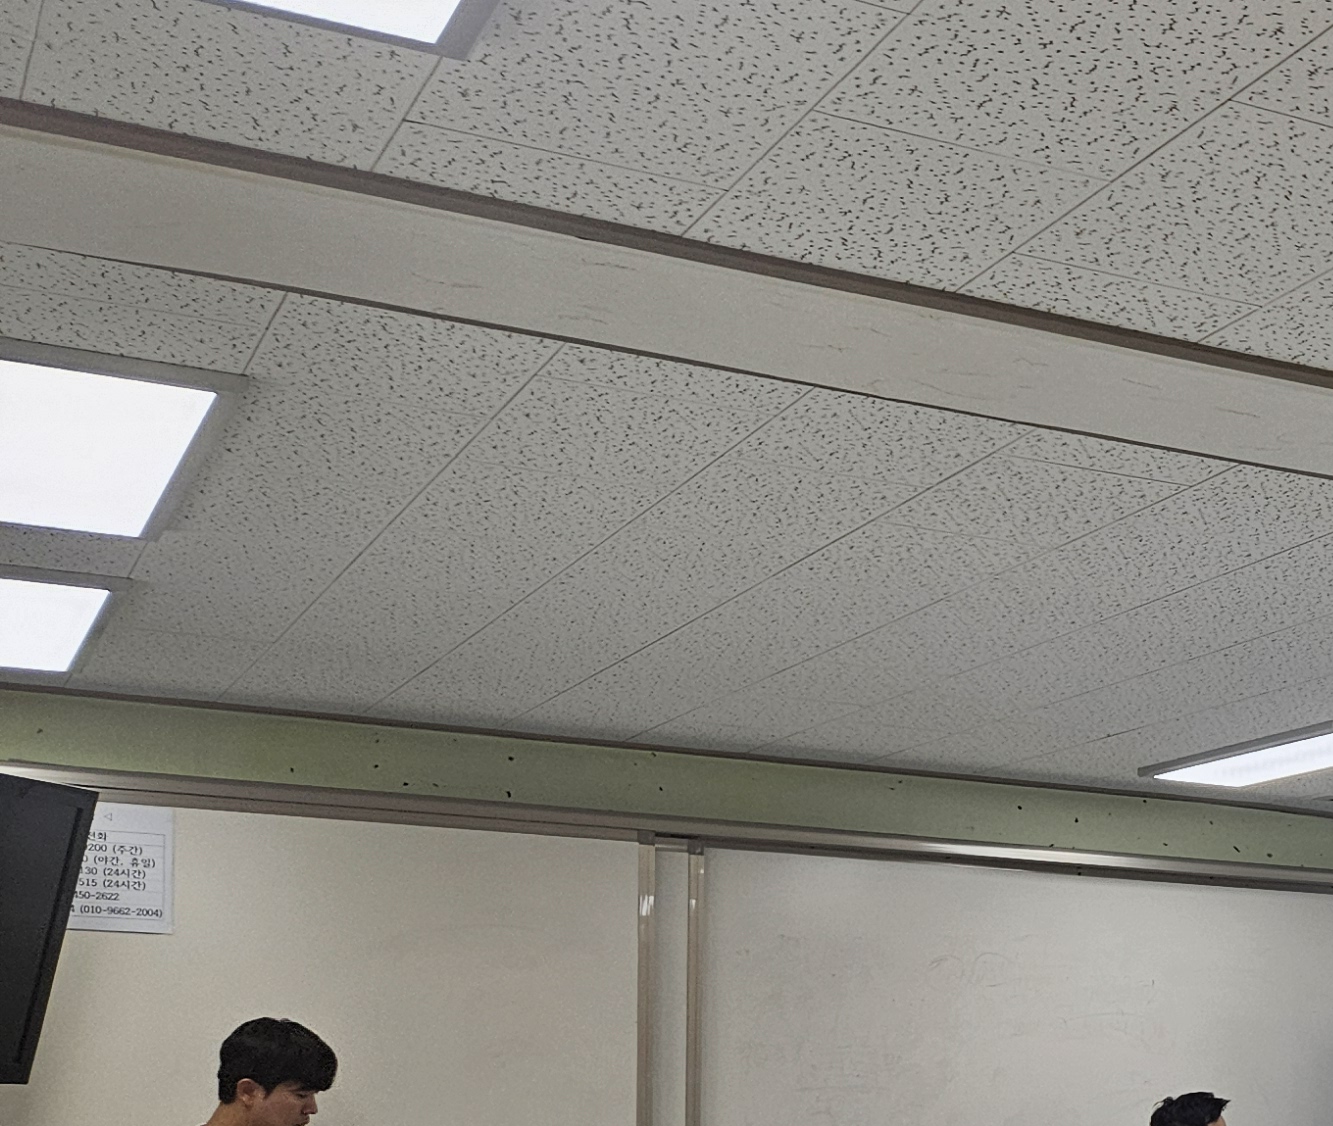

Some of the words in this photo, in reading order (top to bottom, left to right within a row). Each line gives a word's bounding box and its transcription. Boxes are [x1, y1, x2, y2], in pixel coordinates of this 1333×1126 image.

[113, 844, 142, 856] (주간)
[103, 867, 146, 879] (24시간)
[103, 878, 146, 890] (24시간)
